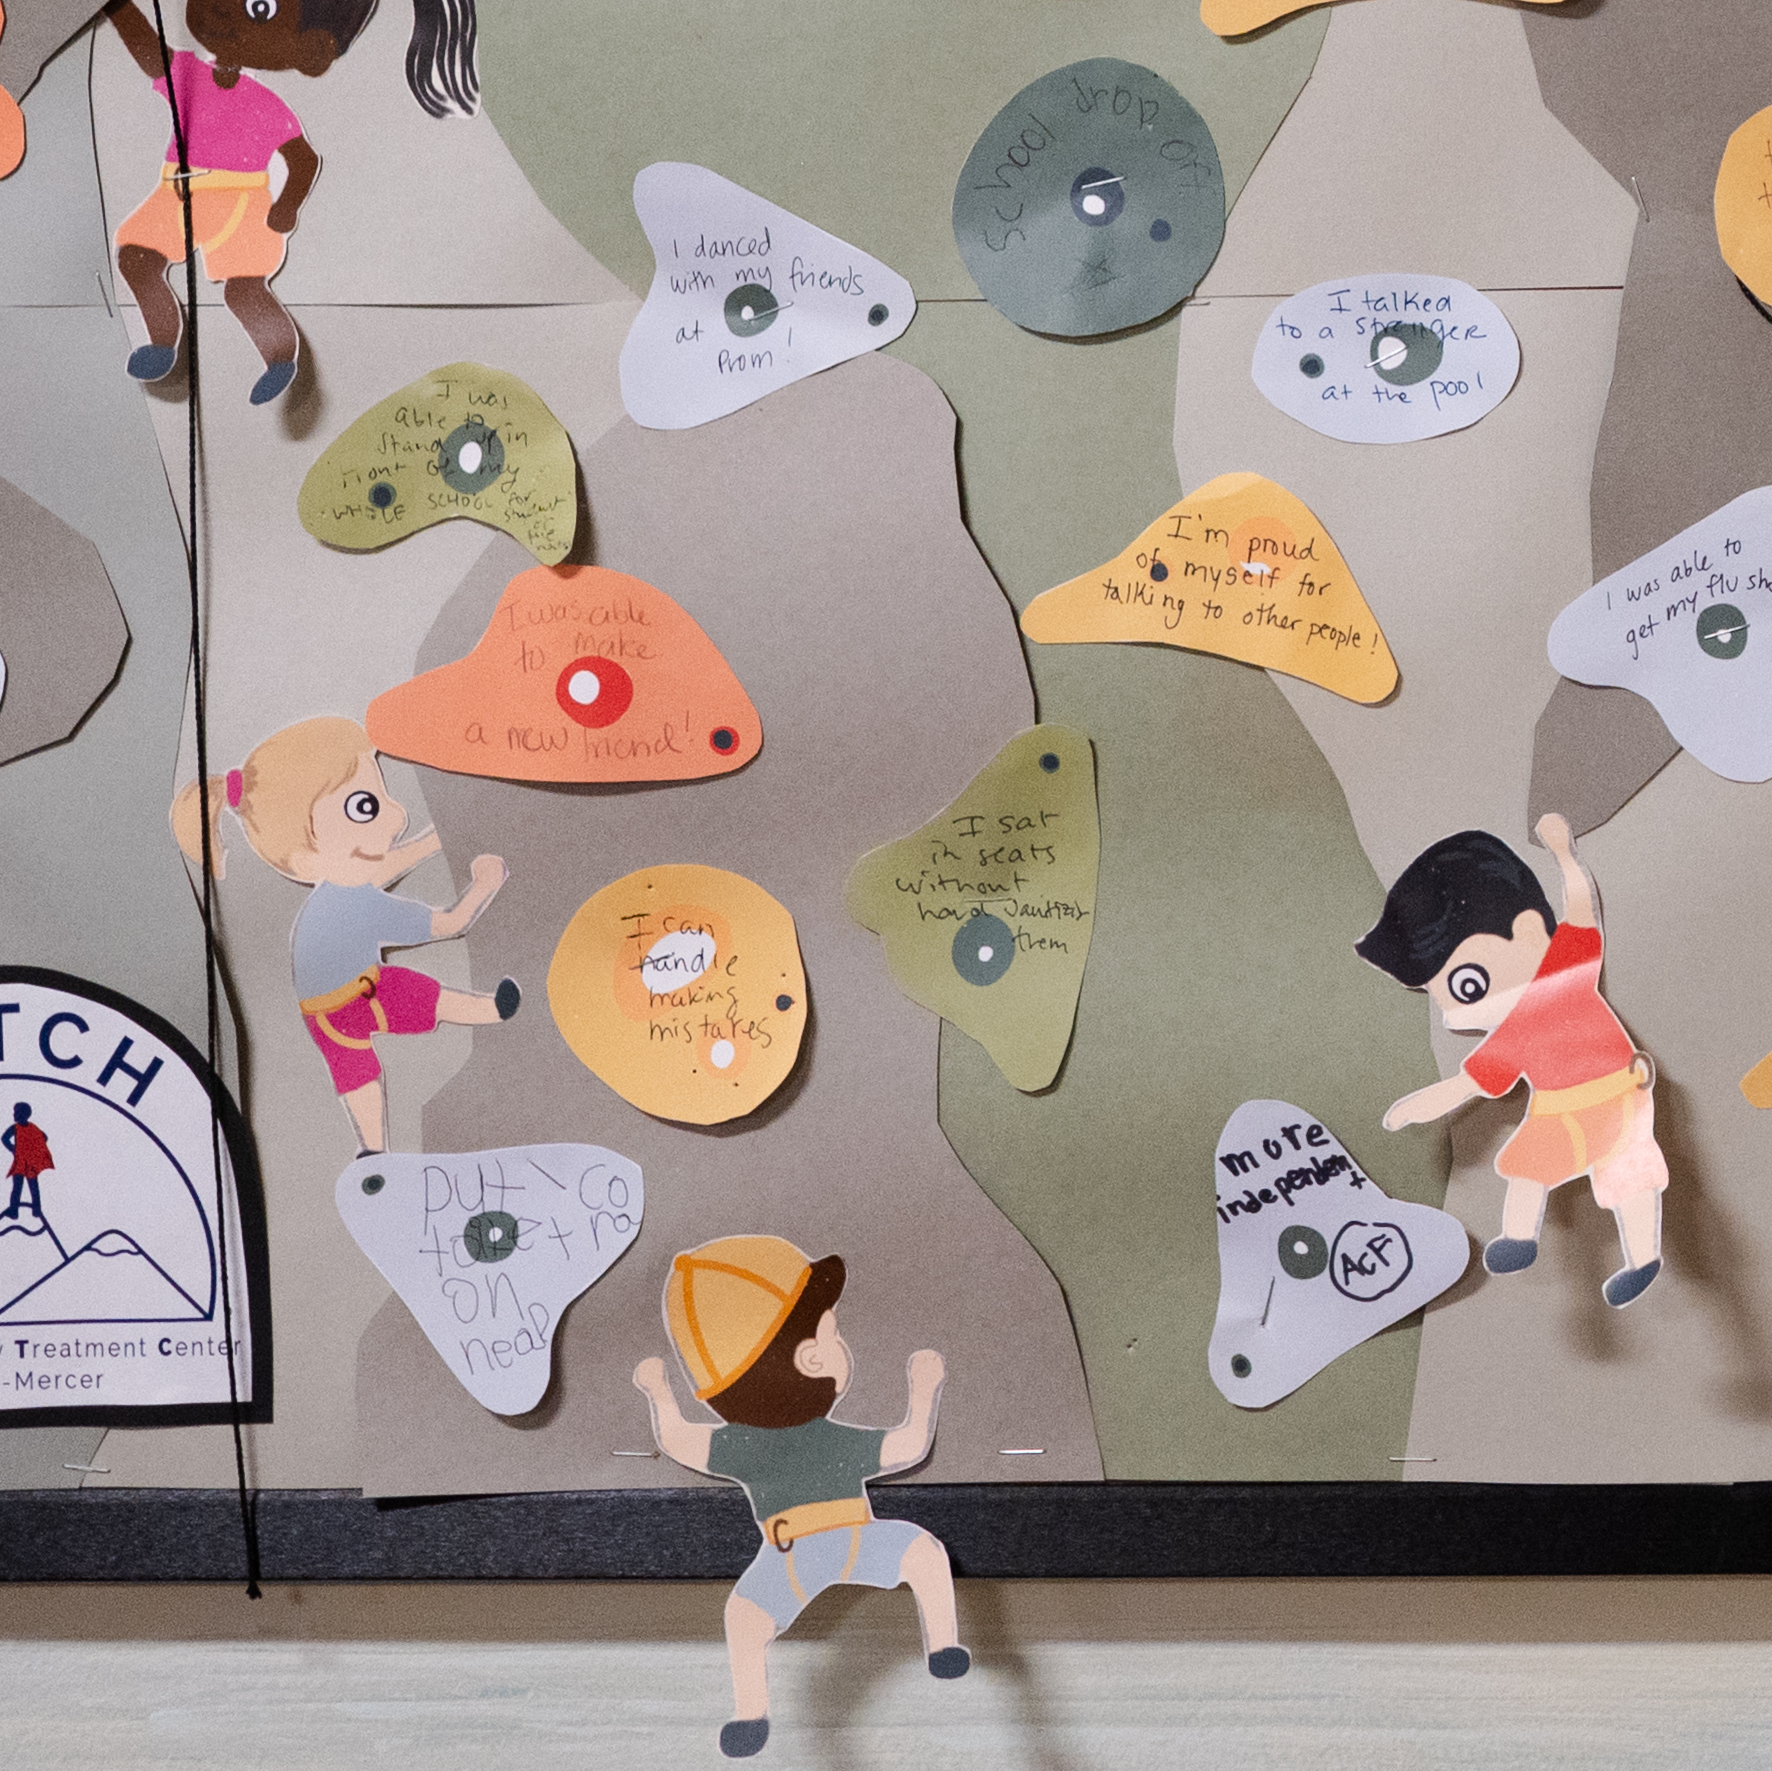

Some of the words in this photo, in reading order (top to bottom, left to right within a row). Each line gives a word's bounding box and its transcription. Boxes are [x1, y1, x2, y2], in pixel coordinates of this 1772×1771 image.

[1070, 77, 1160, 129] drop
[693, 226, 773, 260] danced
[669, 269, 716, 295] with
[735, 264, 773, 292] my
[789, 256, 865, 297] friends
[1326, 289, 1352, 314] I
[1361, 289, 1452, 313] talked
[675, 318, 705, 344] at
[1275, 315, 1303, 340] to
[1320, 384, 1353, 402] at
[1371, 385, 1412, 404] the
[1429, 370, 1484, 412] pool
[394, 407, 447, 430] able
[1166, 514, 1230, 548] I'm
[1245, 537, 1320, 563] proud
[1183, 564, 1281, 589] myself
[1297, 573, 1332, 598] for
[1626, 580, 1661, 603] was
[1670, 550, 1715, 584] able
[1724, 539, 1742, 557] to
[1102, 577, 1185, 631] talking
[1202, 600, 1224, 621] to
[1242, 602, 1303, 633] other
[1625, 614, 1662, 661] get
[1666, 591, 1699, 622] my
[1706, 574, 1739, 599] flu
[507, 726, 570, 753] new
[998, 810, 1060, 836] sat
[979, 843, 1057, 867] seats
[895, 870, 1031, 895] without
[662, 915, 716, 939] can
[649, 985, 739, 1020] making
[1219, 1123, 1331, 1177] more
[1341, 1232, 1394, 1286] ACF
[13, 1336, 148, 1360] Treatment
[157, 1336, 242, 1359] Center
